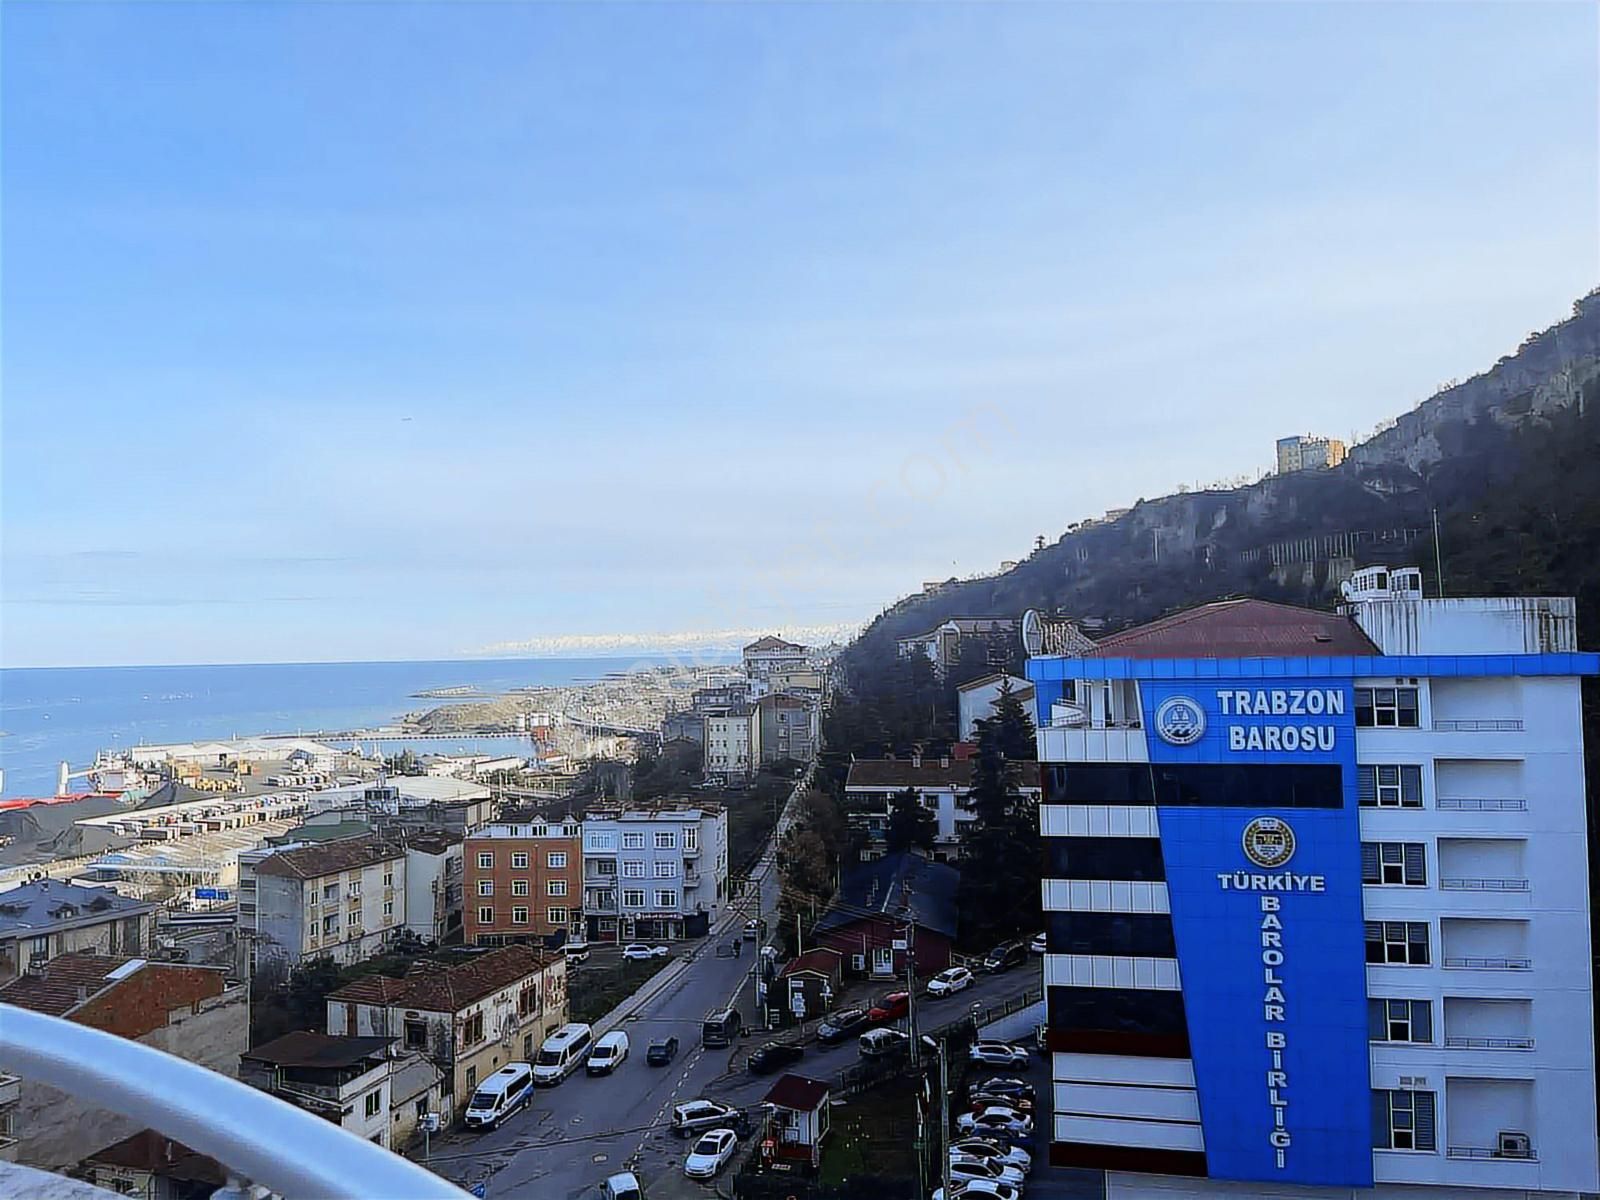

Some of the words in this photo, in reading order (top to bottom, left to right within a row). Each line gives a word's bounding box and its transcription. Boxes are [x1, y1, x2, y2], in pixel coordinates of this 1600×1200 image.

[1217, 689, 1344, 715] TRABZON
[1230, 726, 1335, 751] BAROSU
[1217, 870, 1325, 892] TÜRKİYE
[1261, 896, 1284, 1021] BAROLAR
[1267, 1032, 1291, 1168] BİRLİĞİ
